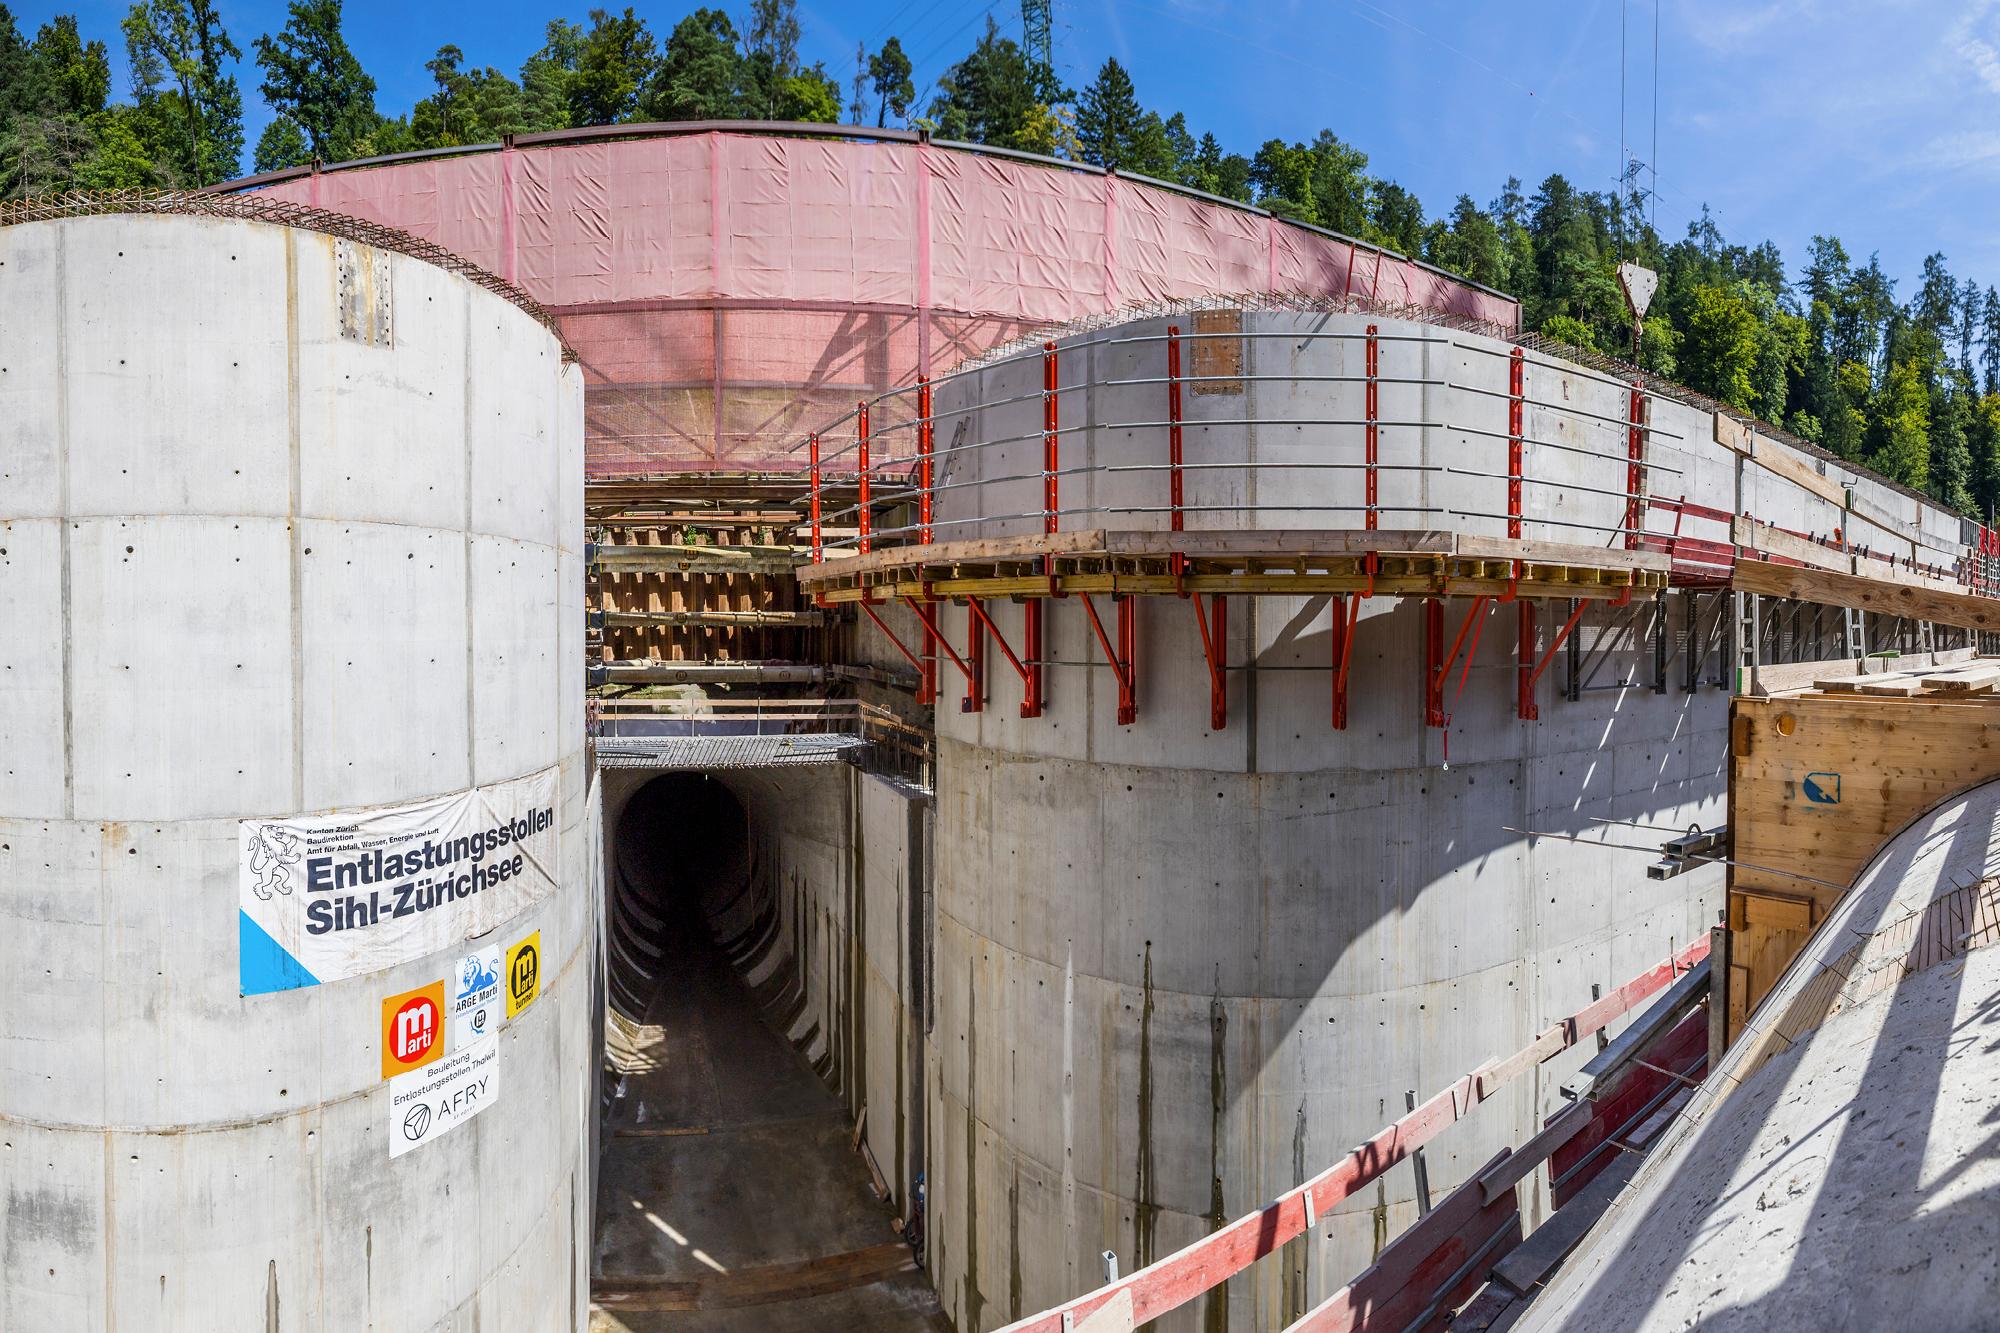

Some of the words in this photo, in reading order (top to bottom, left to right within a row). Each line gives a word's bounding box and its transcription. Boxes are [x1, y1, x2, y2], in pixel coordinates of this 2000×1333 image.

[307, 834, 354, 845] Baudirektion
[307, 847, 323, 855] Amt
[324, 845, 335, 853] für
[337, 843, 360, 852] Abfall,
[361, 839, 388, 849] Wasser,
[389, 833, 414, 844] Energie
[415, 831, 427, 839] und
[335, 824, 359, 833] Zürich
[307, 807, 553, 892] Entlastungsstollen
[306, 855, 523, 935] Sihl-Zürichsee
[456, 995, 477, 1013] ARGE
[479, 984, 498, 1002] Marti
[393, 1066, 471, 1105] Entlastungsstollen
[471, 1049, 496, 1069] Thalwil
[427, 1053, 470, 1077] Bauleitung
[438, 1075, 489, 1120] AFRY
